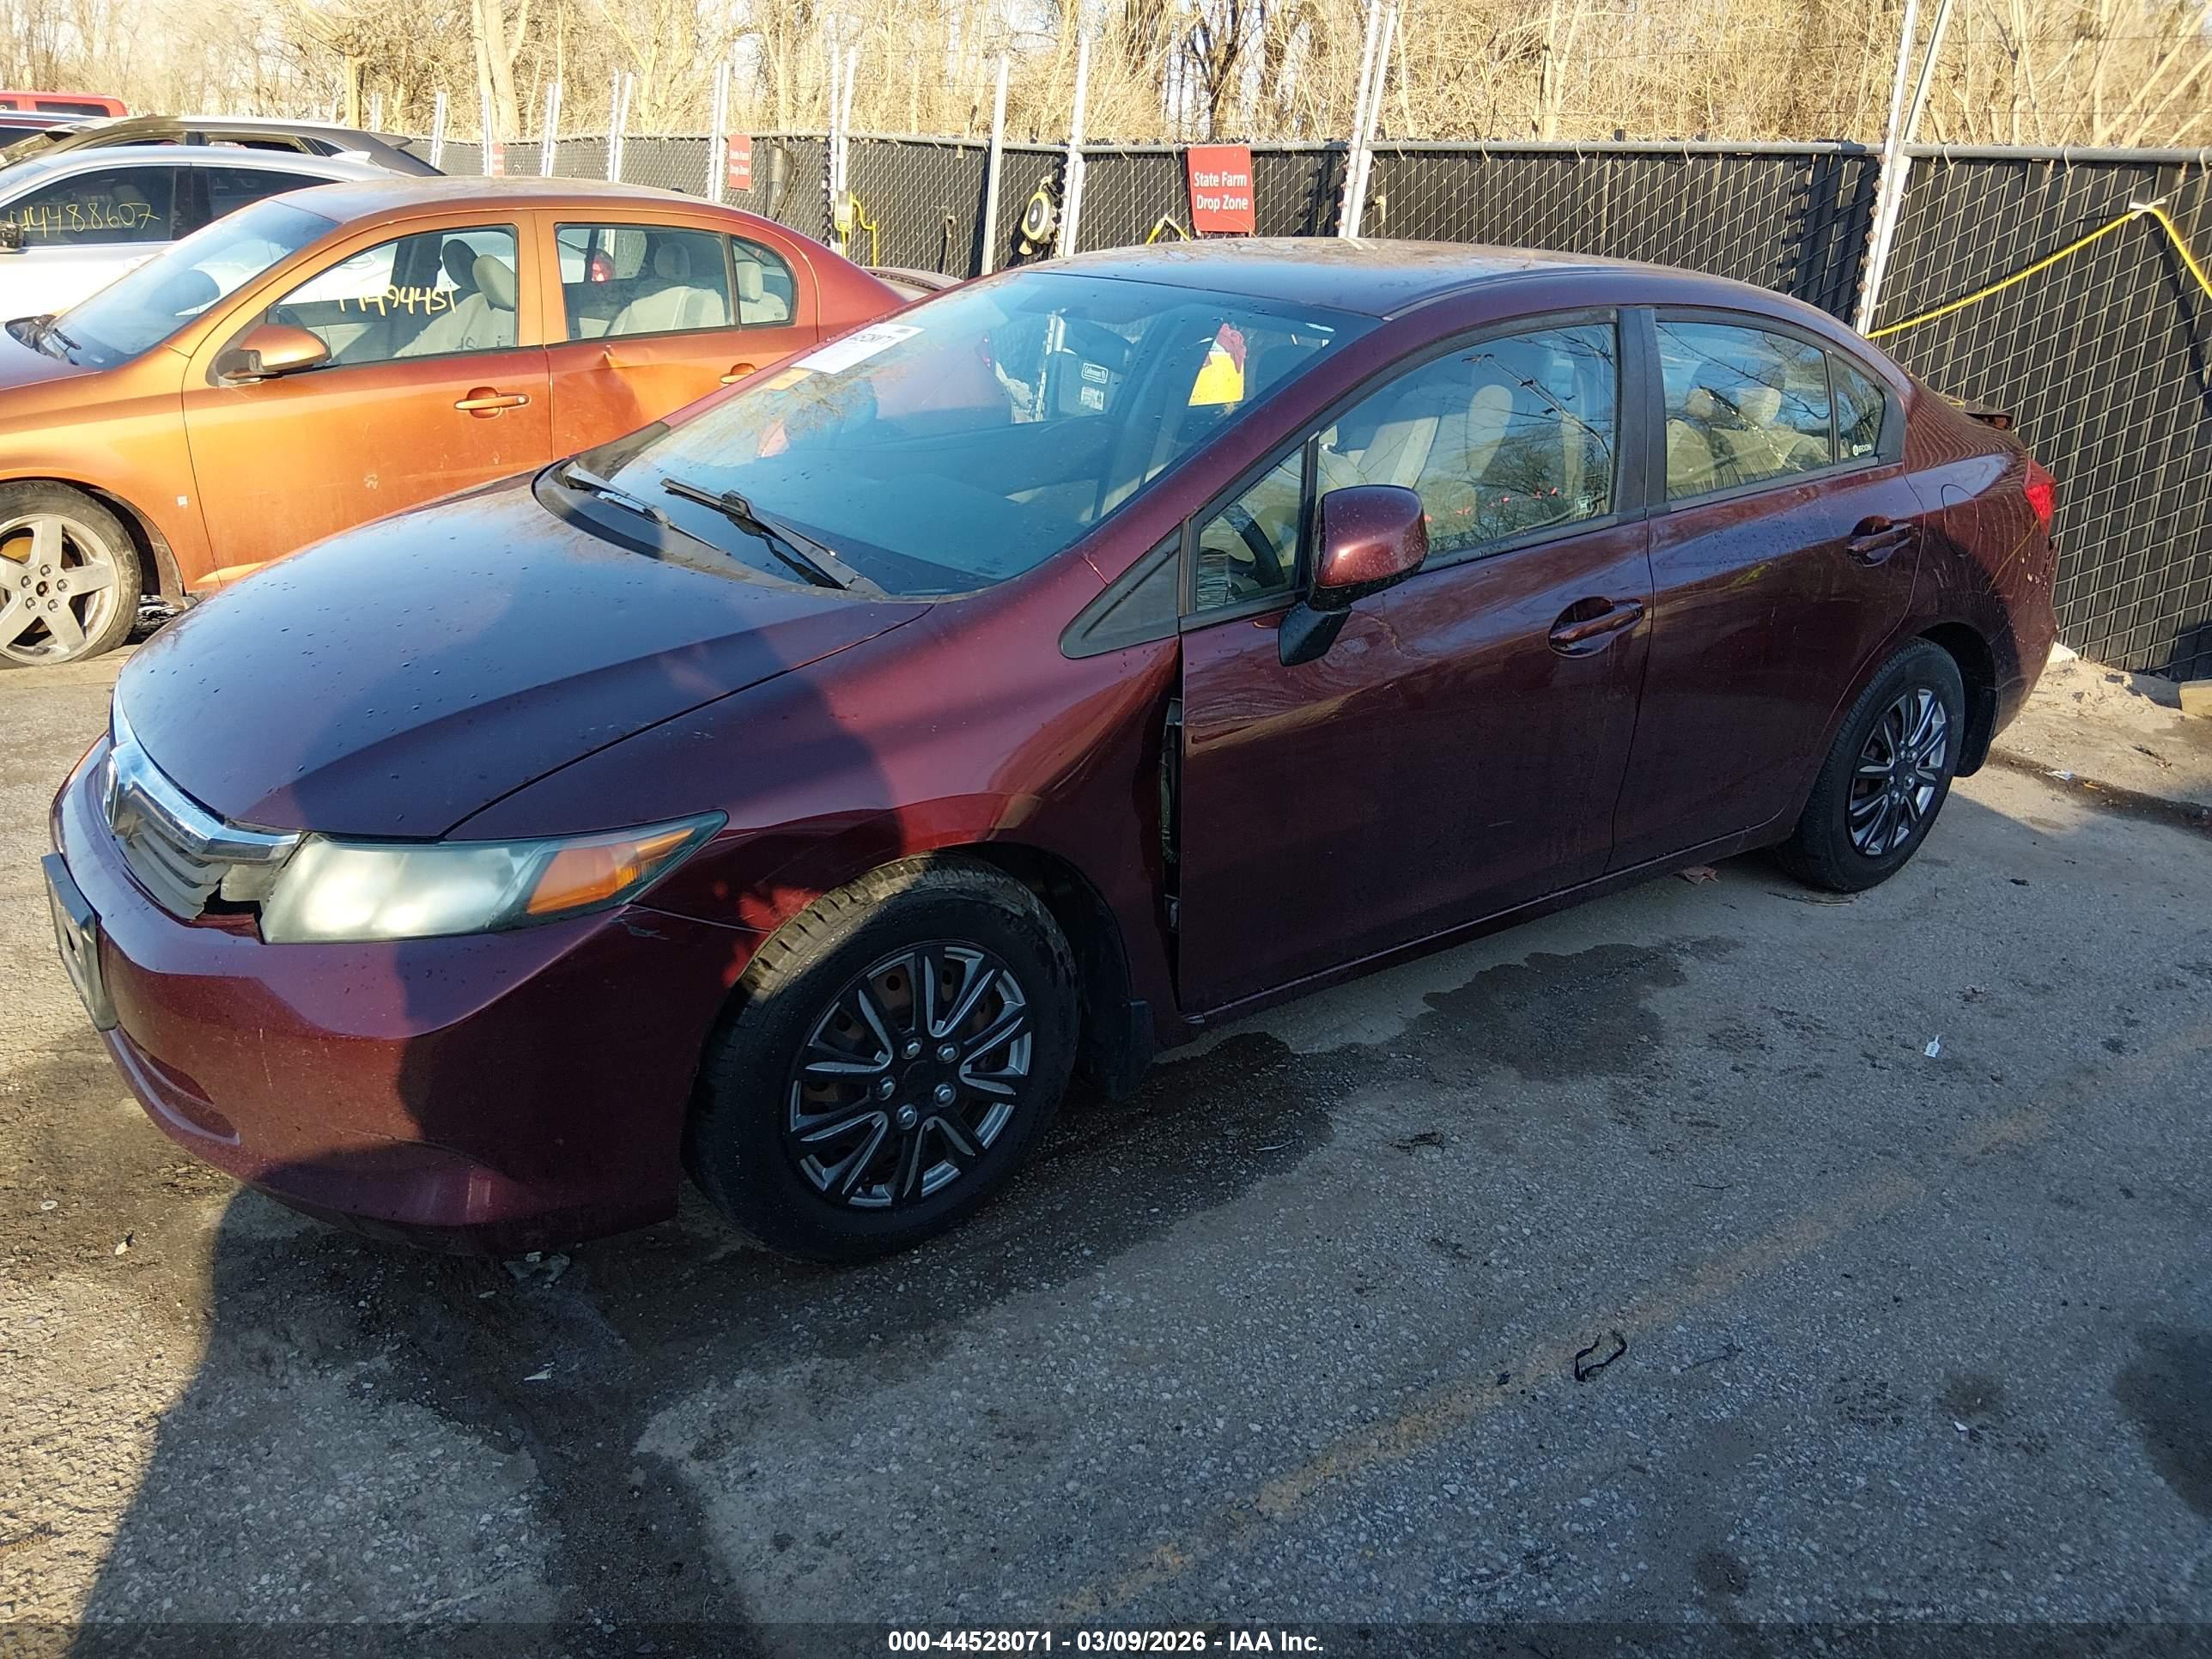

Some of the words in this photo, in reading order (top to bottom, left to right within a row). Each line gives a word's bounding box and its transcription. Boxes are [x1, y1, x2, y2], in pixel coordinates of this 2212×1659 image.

[1194, 172, 1219, 187] State
[1221, 172, 1247, 187] Farm
[1196, 194, 1220, 213] Drop
[1222, 194, 1249, 210] Zone
